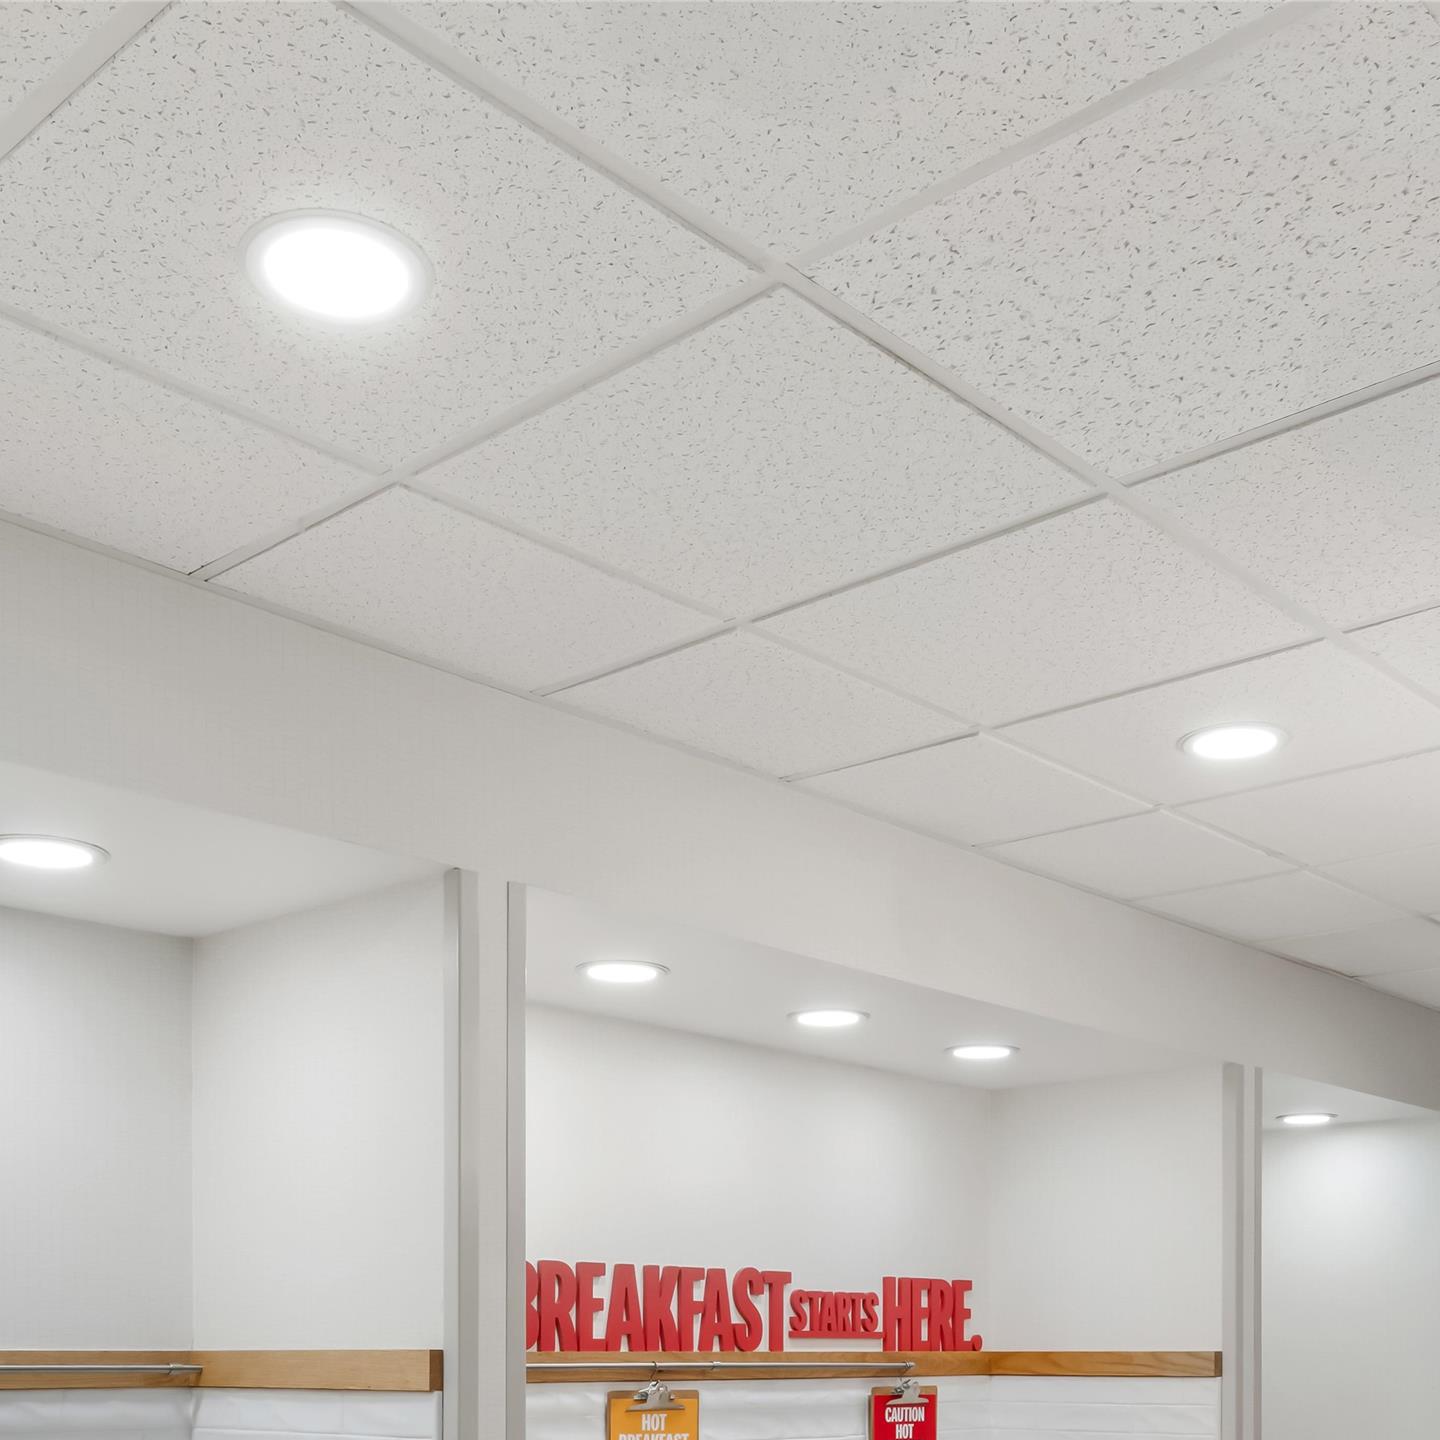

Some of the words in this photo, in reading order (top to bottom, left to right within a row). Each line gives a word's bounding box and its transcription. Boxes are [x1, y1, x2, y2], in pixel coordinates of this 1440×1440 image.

[789, 1289, 879, 1332] STARTS
[882, 1277, 983, 1352] HERE.
[885, 1406, 925, 1422] CAUTION
[642, 1414, 667, 1431] HOT
[896, 1423, 914, 1439] HOT
